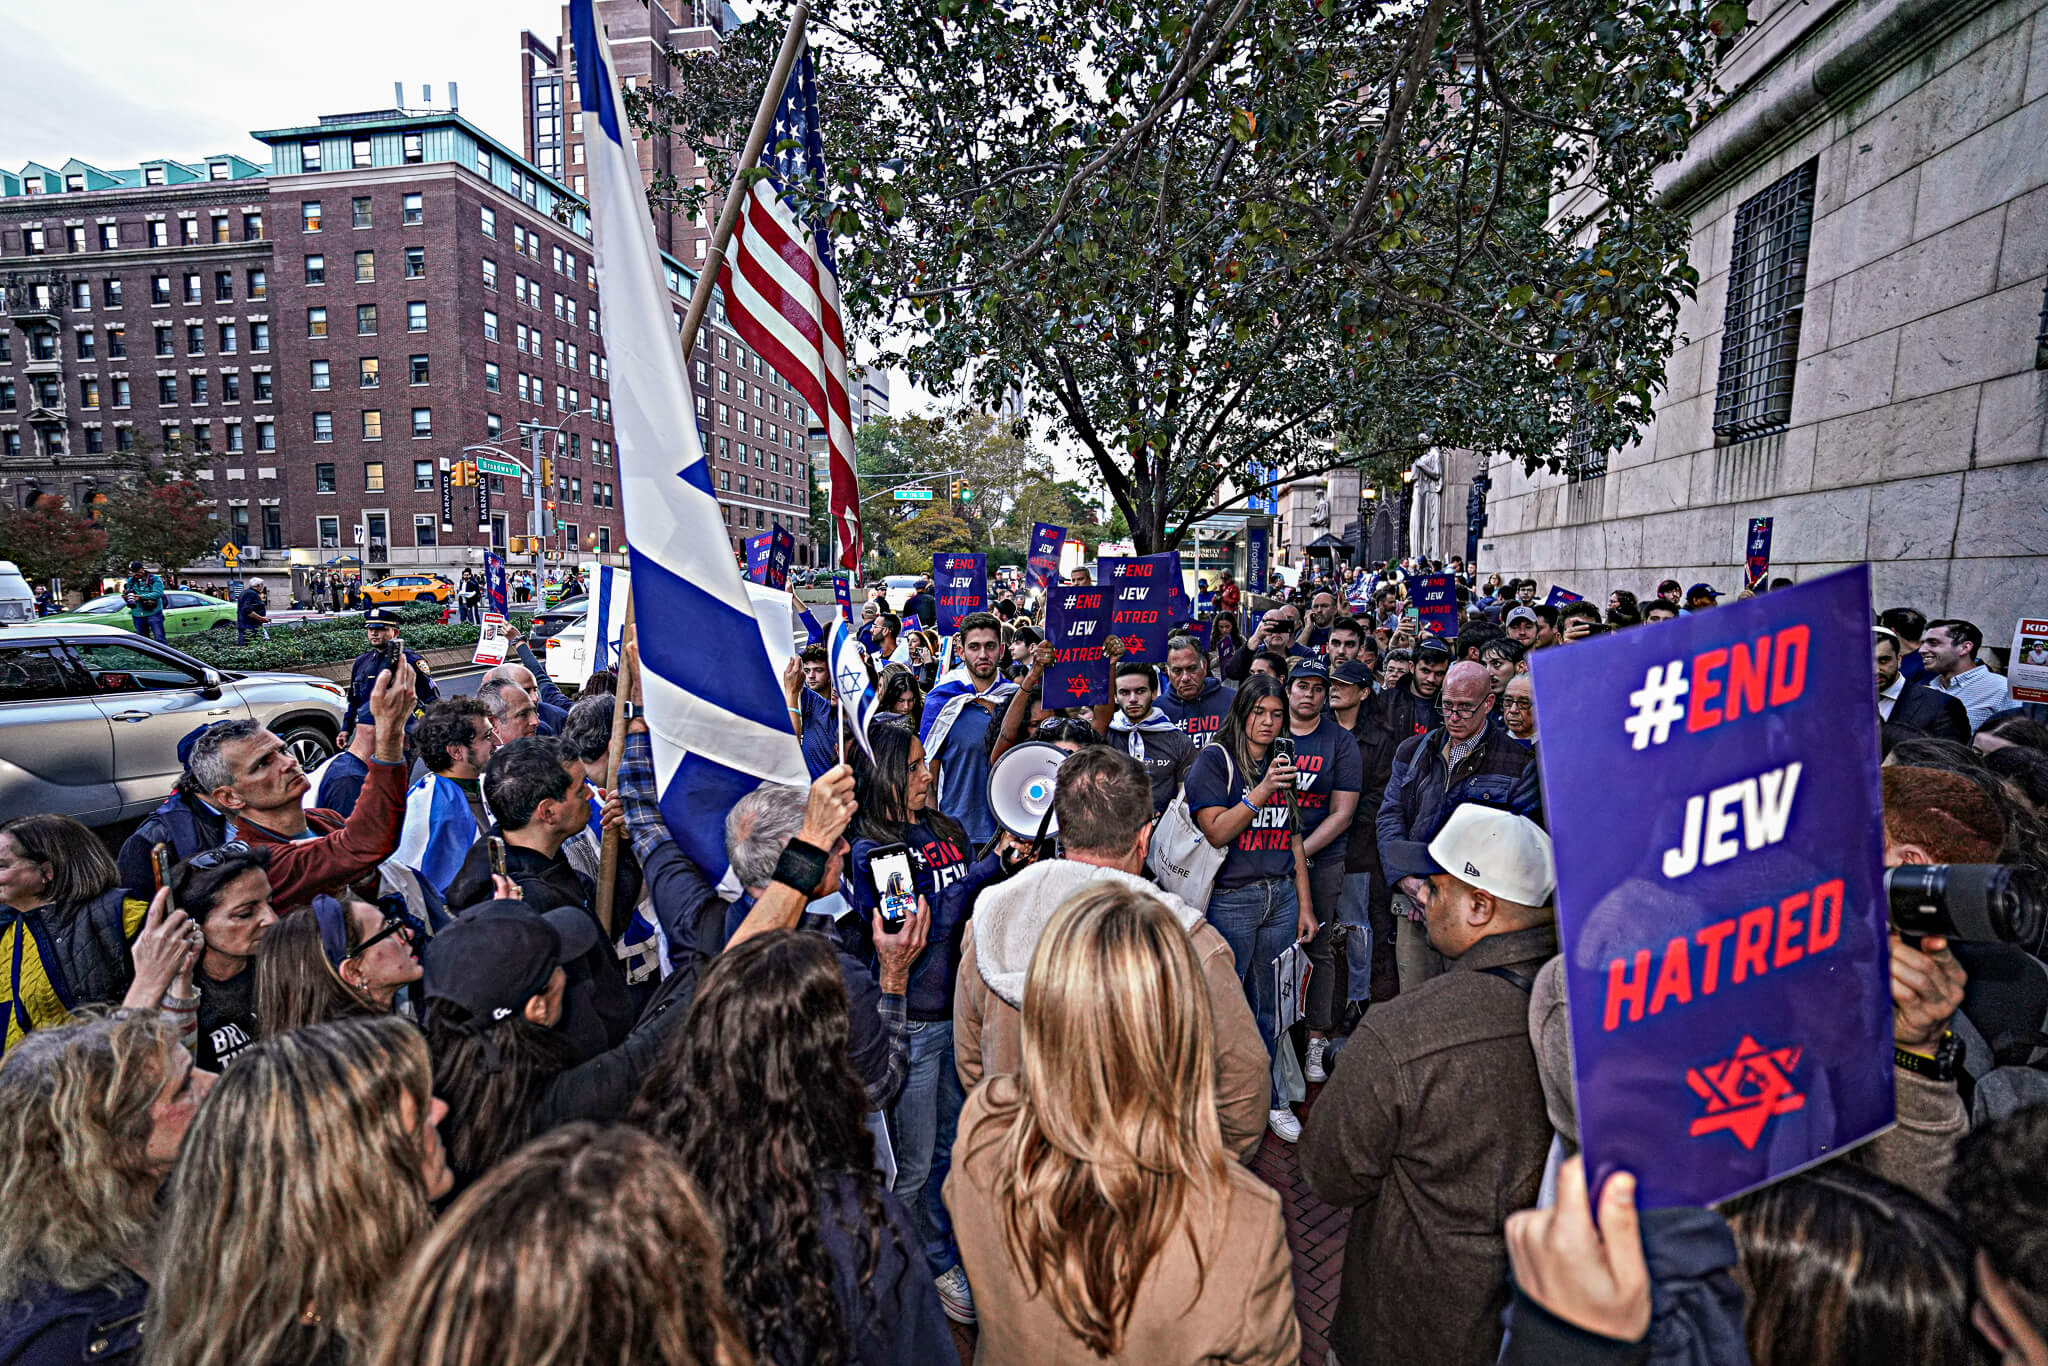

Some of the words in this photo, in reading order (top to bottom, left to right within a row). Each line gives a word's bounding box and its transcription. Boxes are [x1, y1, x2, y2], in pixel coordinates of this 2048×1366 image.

[483, 461, 514, 475] Broadway
[1038, 543, 1054, 554] JEW
[945, 559, 974, 570] #END
[1113, 563, 1154, 577] #END
[1251, 542, 1260, 586] Broadway
[950, 577, 972, 588] JEW
[1421, 578, 1445, 588] #END
[1118, 587, 1150, 600] JEW
[1425, 591, 1445, 601] JEW
[940, 596, 980, 607] HATRED
[1064, 594, 1102, 609] #END
[1067, 620, 1097, 636] JEW
[1054, 646, 1103, 663] HATRED
[1624, 623, 1810, 750] #END
[1175, 715, 1219, 733] #END
[1252, 807, 1289, 828] JEW
[1662, 762, 1803, 879] JEW
[1239, 830, 1291, 851] HATRE
[1168, 863, 1191, 879] HERE
[1602, 878, 1845, 1032] HATRED
